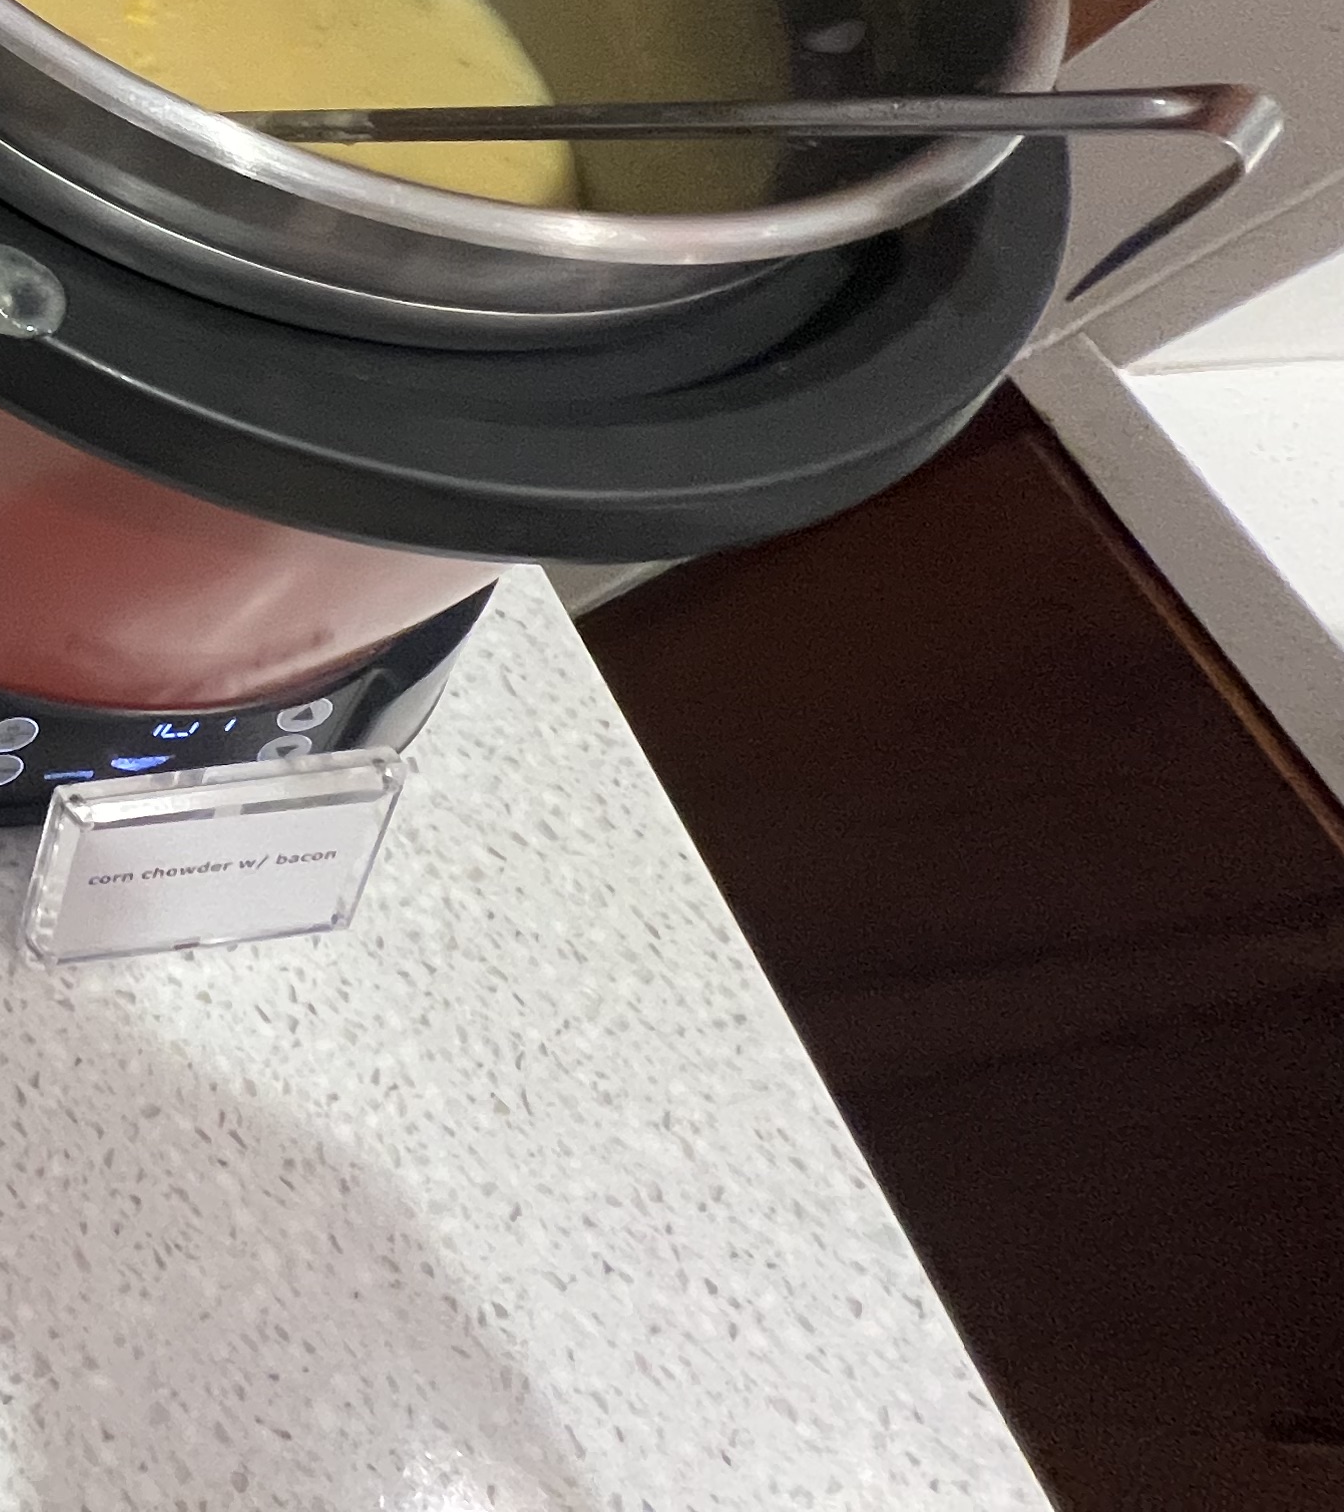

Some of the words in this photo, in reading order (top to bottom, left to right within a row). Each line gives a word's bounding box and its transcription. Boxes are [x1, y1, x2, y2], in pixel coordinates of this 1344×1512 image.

[88, 872, 134, 886] corn
[141, 861, 233, 880] chowder
[239, 855, 270, 871] w/
[275, 850, 338, 866] bacon
